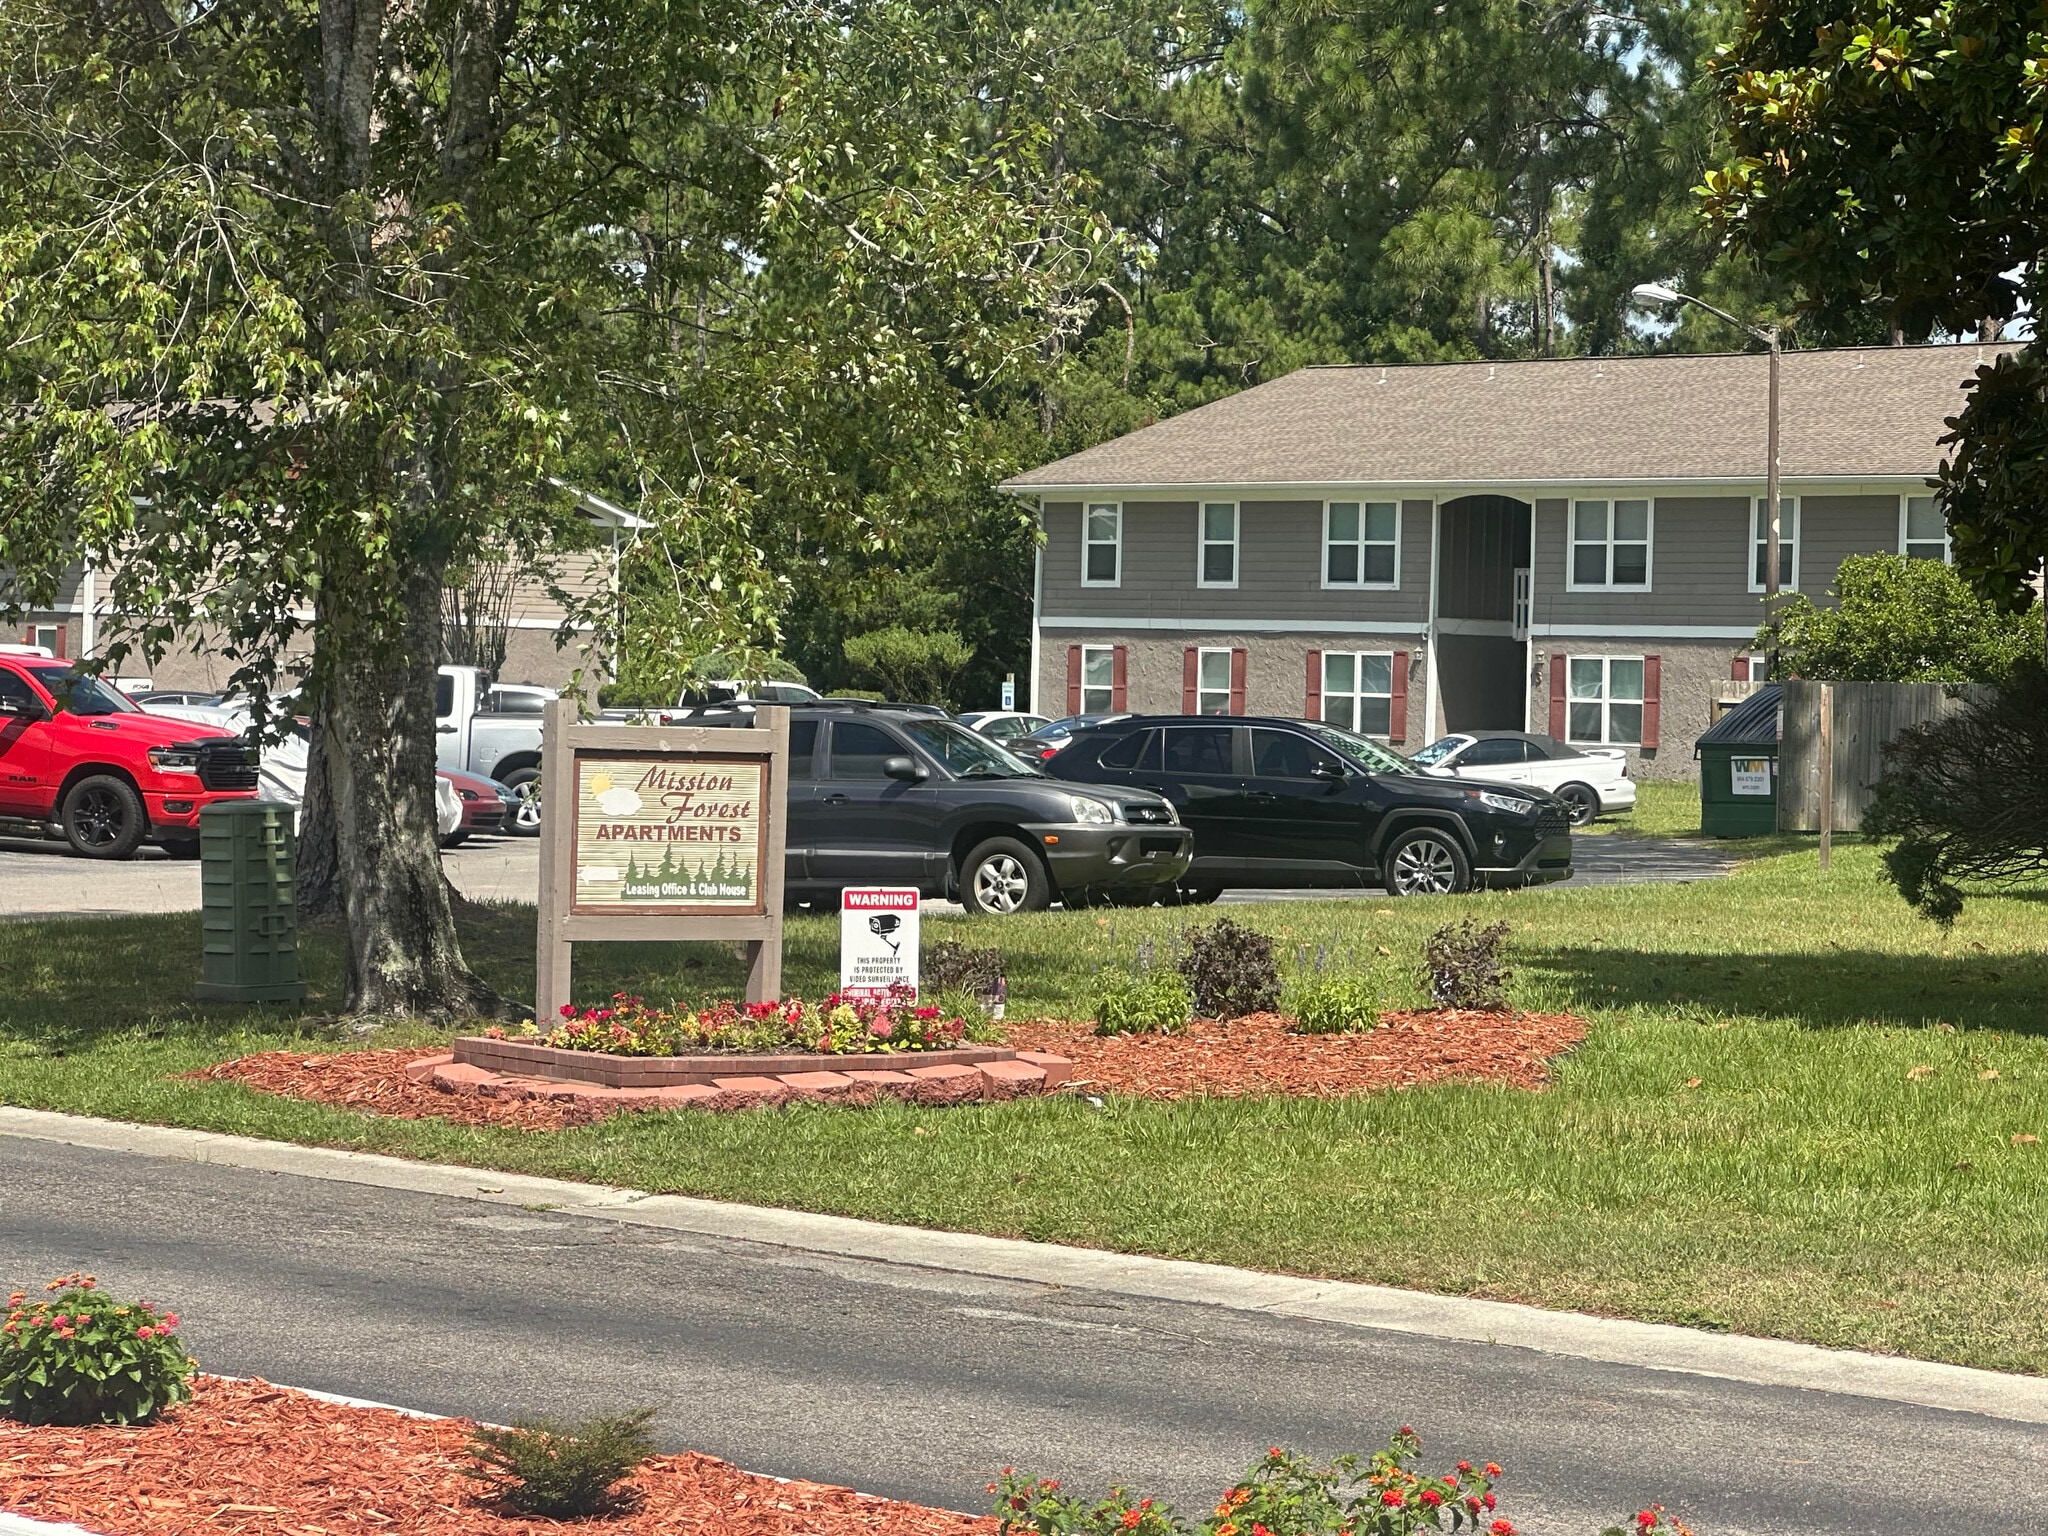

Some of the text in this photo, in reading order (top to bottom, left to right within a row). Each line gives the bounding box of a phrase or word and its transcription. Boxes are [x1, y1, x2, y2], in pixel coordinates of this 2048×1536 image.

[1734, 759, 1765, 773] WM
[8, 775, 37, 783] RAM
[635, 764, 732, 792] Mission
[660, 791, 750, 824] Forest
[596, 824, 742, 842] APARTMENTS
[626, 883, 747, 898] Leasing Office & Club House
[848, 893, 914, 906] WARNING
[853, 966, 904, 974] IS PROTECTED BY
